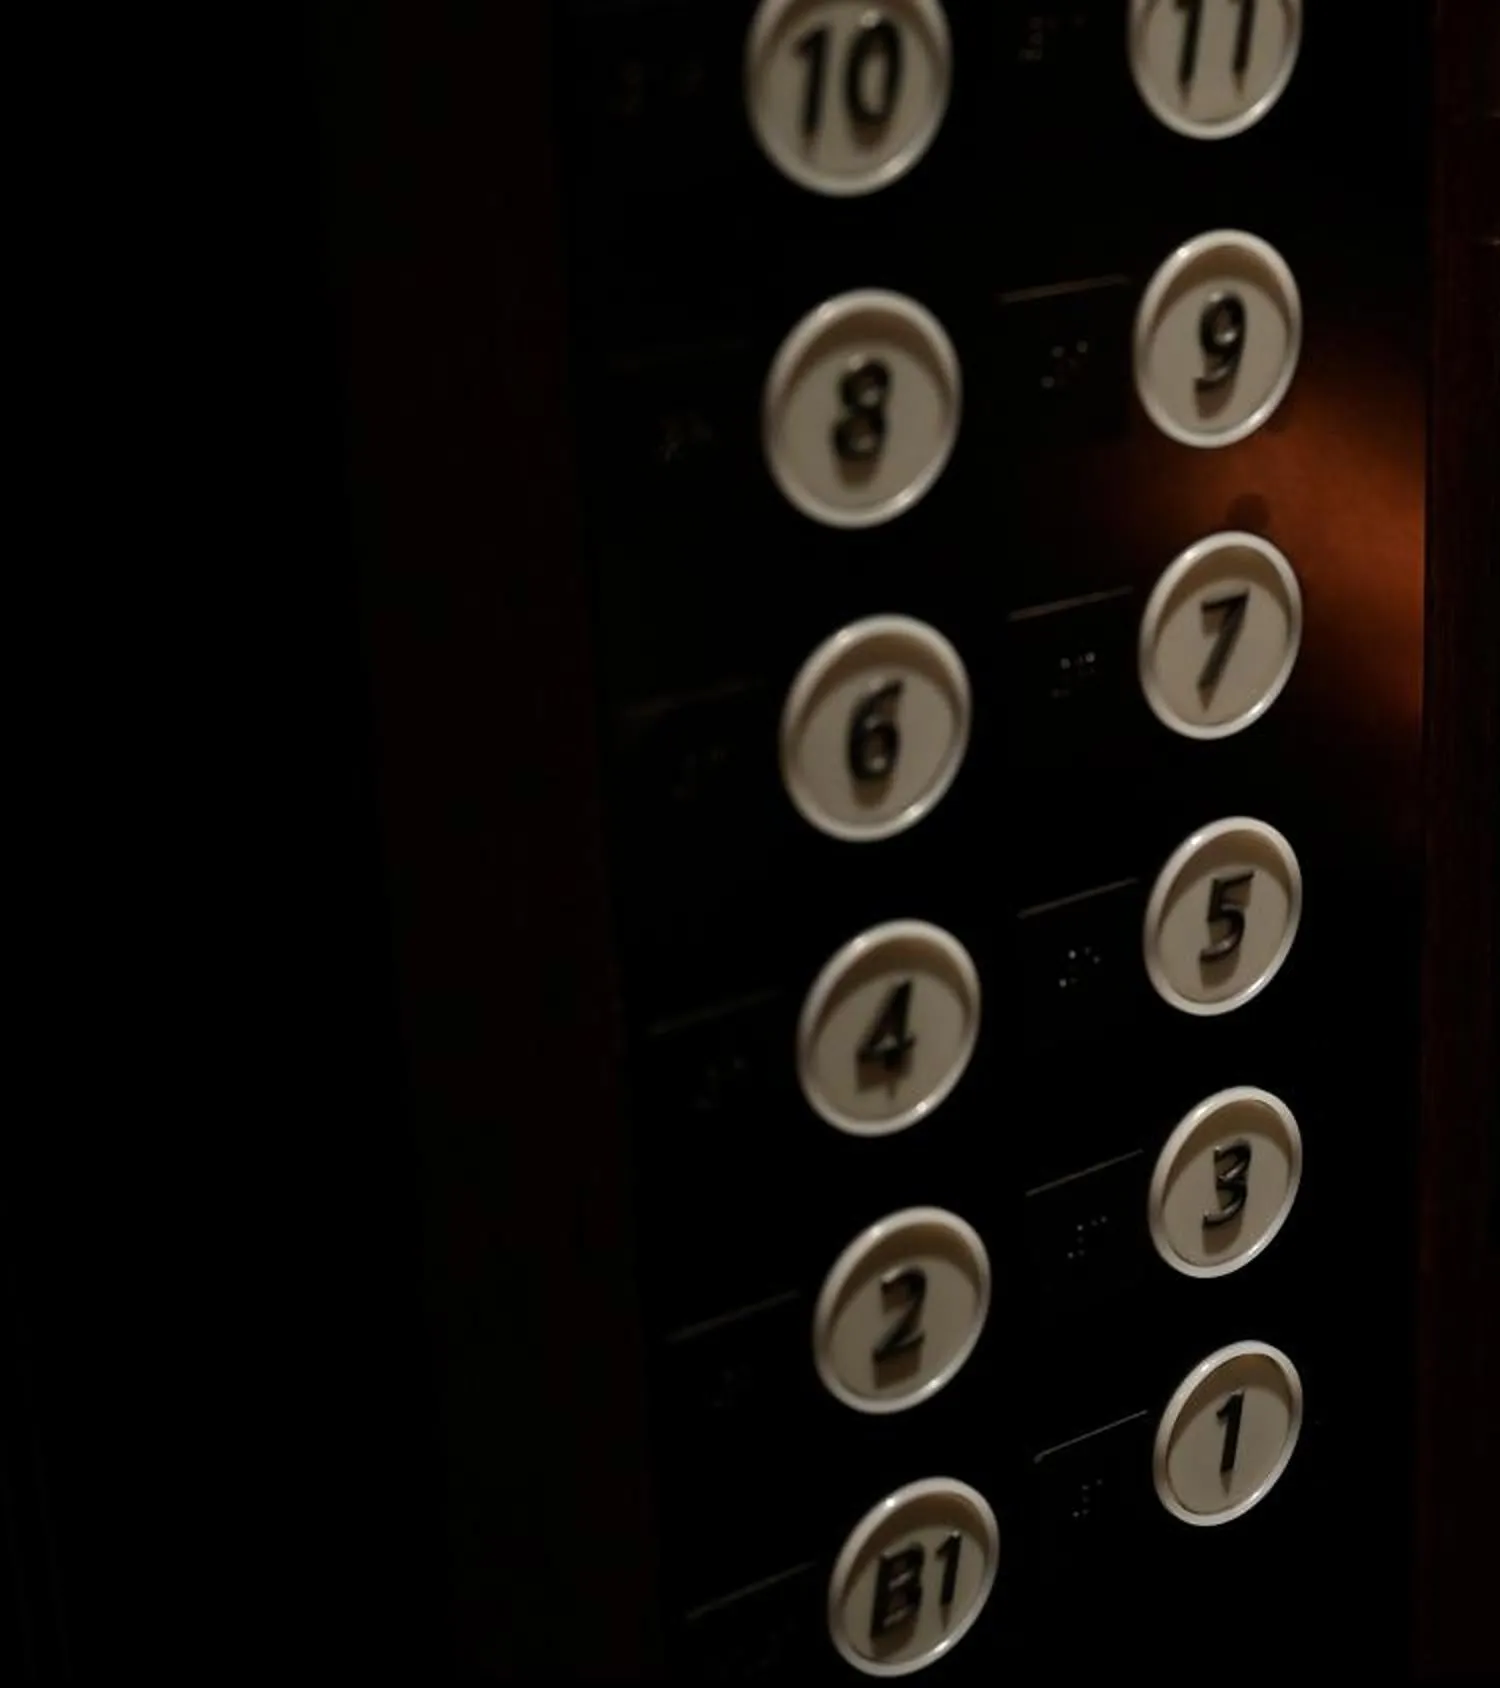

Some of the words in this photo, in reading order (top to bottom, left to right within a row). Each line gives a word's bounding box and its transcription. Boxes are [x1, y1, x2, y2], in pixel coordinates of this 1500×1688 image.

[796, 19, 905, 140] 10
[1174, 0, 1258, 90] 11
[1195, 290, 1247, 392] 9
[831, 355, 891, 464] 8
[1197, 588, 1250, 702] 7
[847, 671, 905, 784] 6
[1198, 869, 1256, 966] 5
[855, 977, 916, 1085] 4
[1202, 1138, 1252, 1228] 3
[872, 1265, 927, 1364] 2
[1215, 1389, 1245, 1476] 1
[869, 1528, 963, 1642] B1
